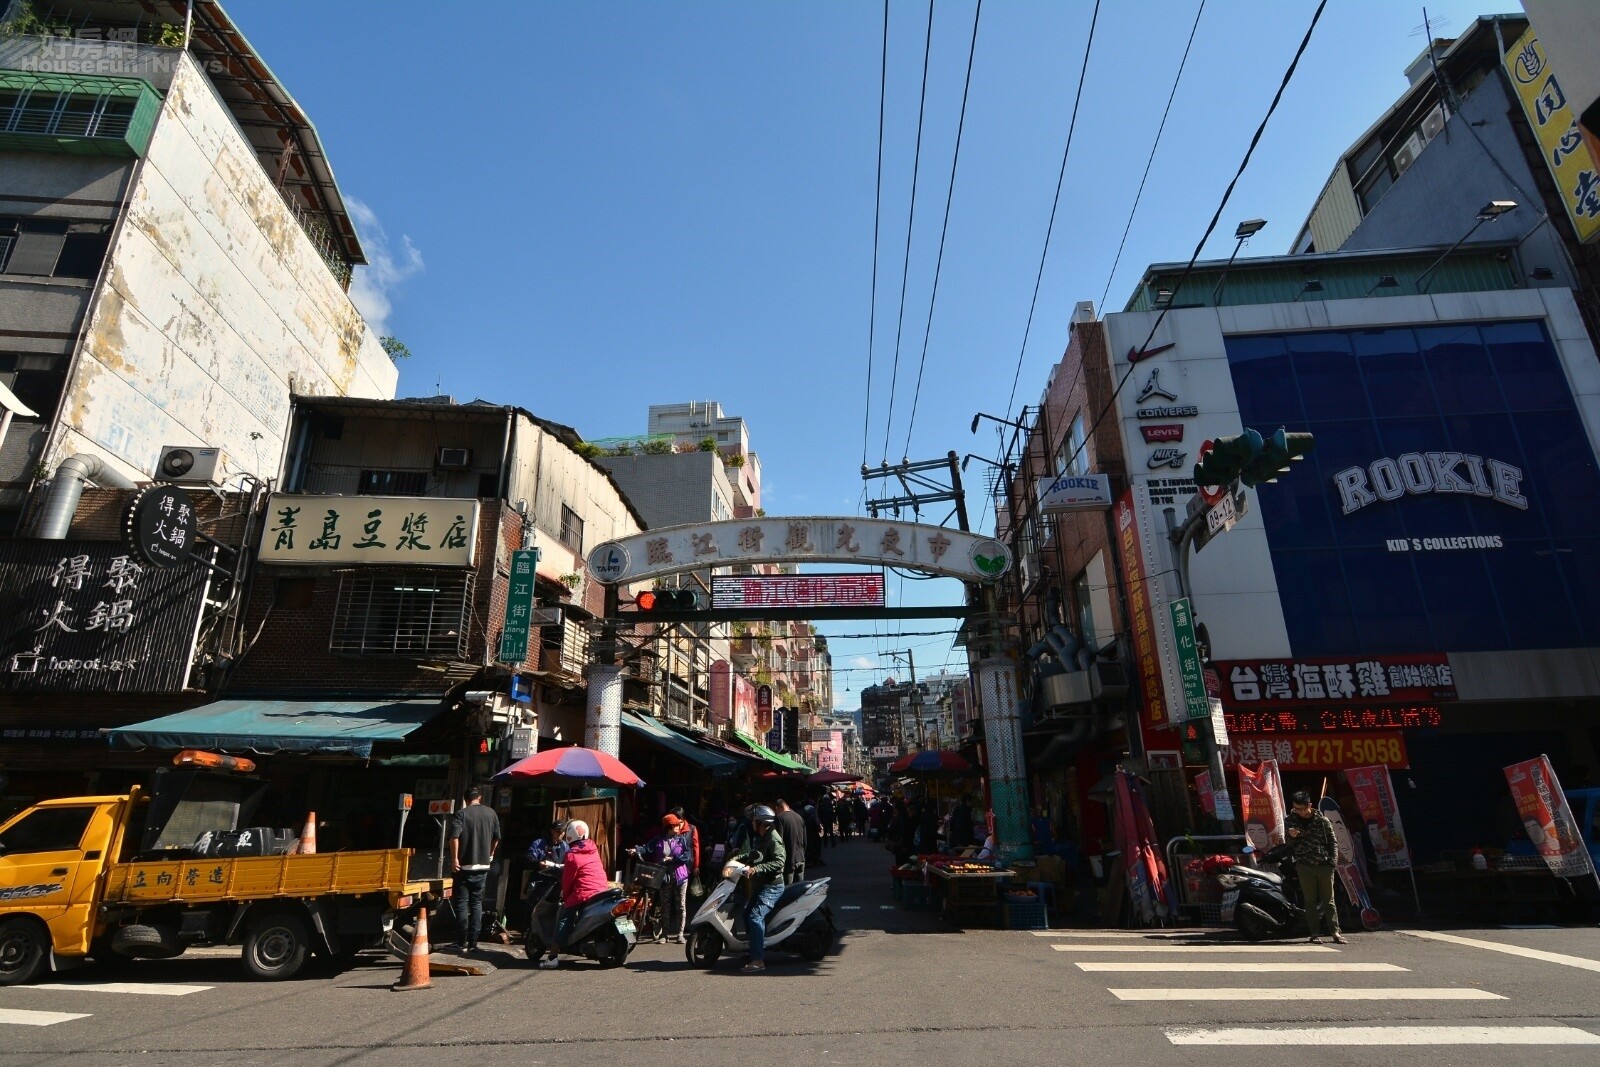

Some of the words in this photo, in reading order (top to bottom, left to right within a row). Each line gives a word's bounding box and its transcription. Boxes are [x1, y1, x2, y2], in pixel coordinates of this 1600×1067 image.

[1154, 449, 1178, 460] NIKE
[1171, 458, 1184, 468] SB
[1053, 477, 1100, 493] ROOKIE
[1149, 487, 1177, 496] BRANDS
[1178, 486, 1198, 495] FROM
[1334, 452, 1528, 515] ROOKIE
[158, 494, 190, 525] 得聚
[1150, 496, 1160, 505] TO
[1160, 496, 1174, 504] TOE
[1209, 498, 1233, 529] 09-12
[153, 518, 186, 548] 火鍋
[271, 506, 469, 550] 青島豆漿店
[1422, 535, 1503, 550] COLLECTIONS
[646, 523, 951, 566] 臨江街觀光夜市
[50, 554, 144, 594] 得聚
[511, 561, 530, 618] 臨江街
[35, 600, 135, 634] 火鍋
[505, 626, 525, 634] Jiang
[1176, 612, 1196, 672] 通化街
[1184, 673, 1198, 682] Tong
[1230, 660, 1391, 702] 台灣塩酥雞
[1387, 663, 1454, 690] 創始總店
[1224, 740, 1295, 766] 外送專線
[1295, 738, 1402, 765] 2737-5058
[133, 866, 224, 888] 立向營造
